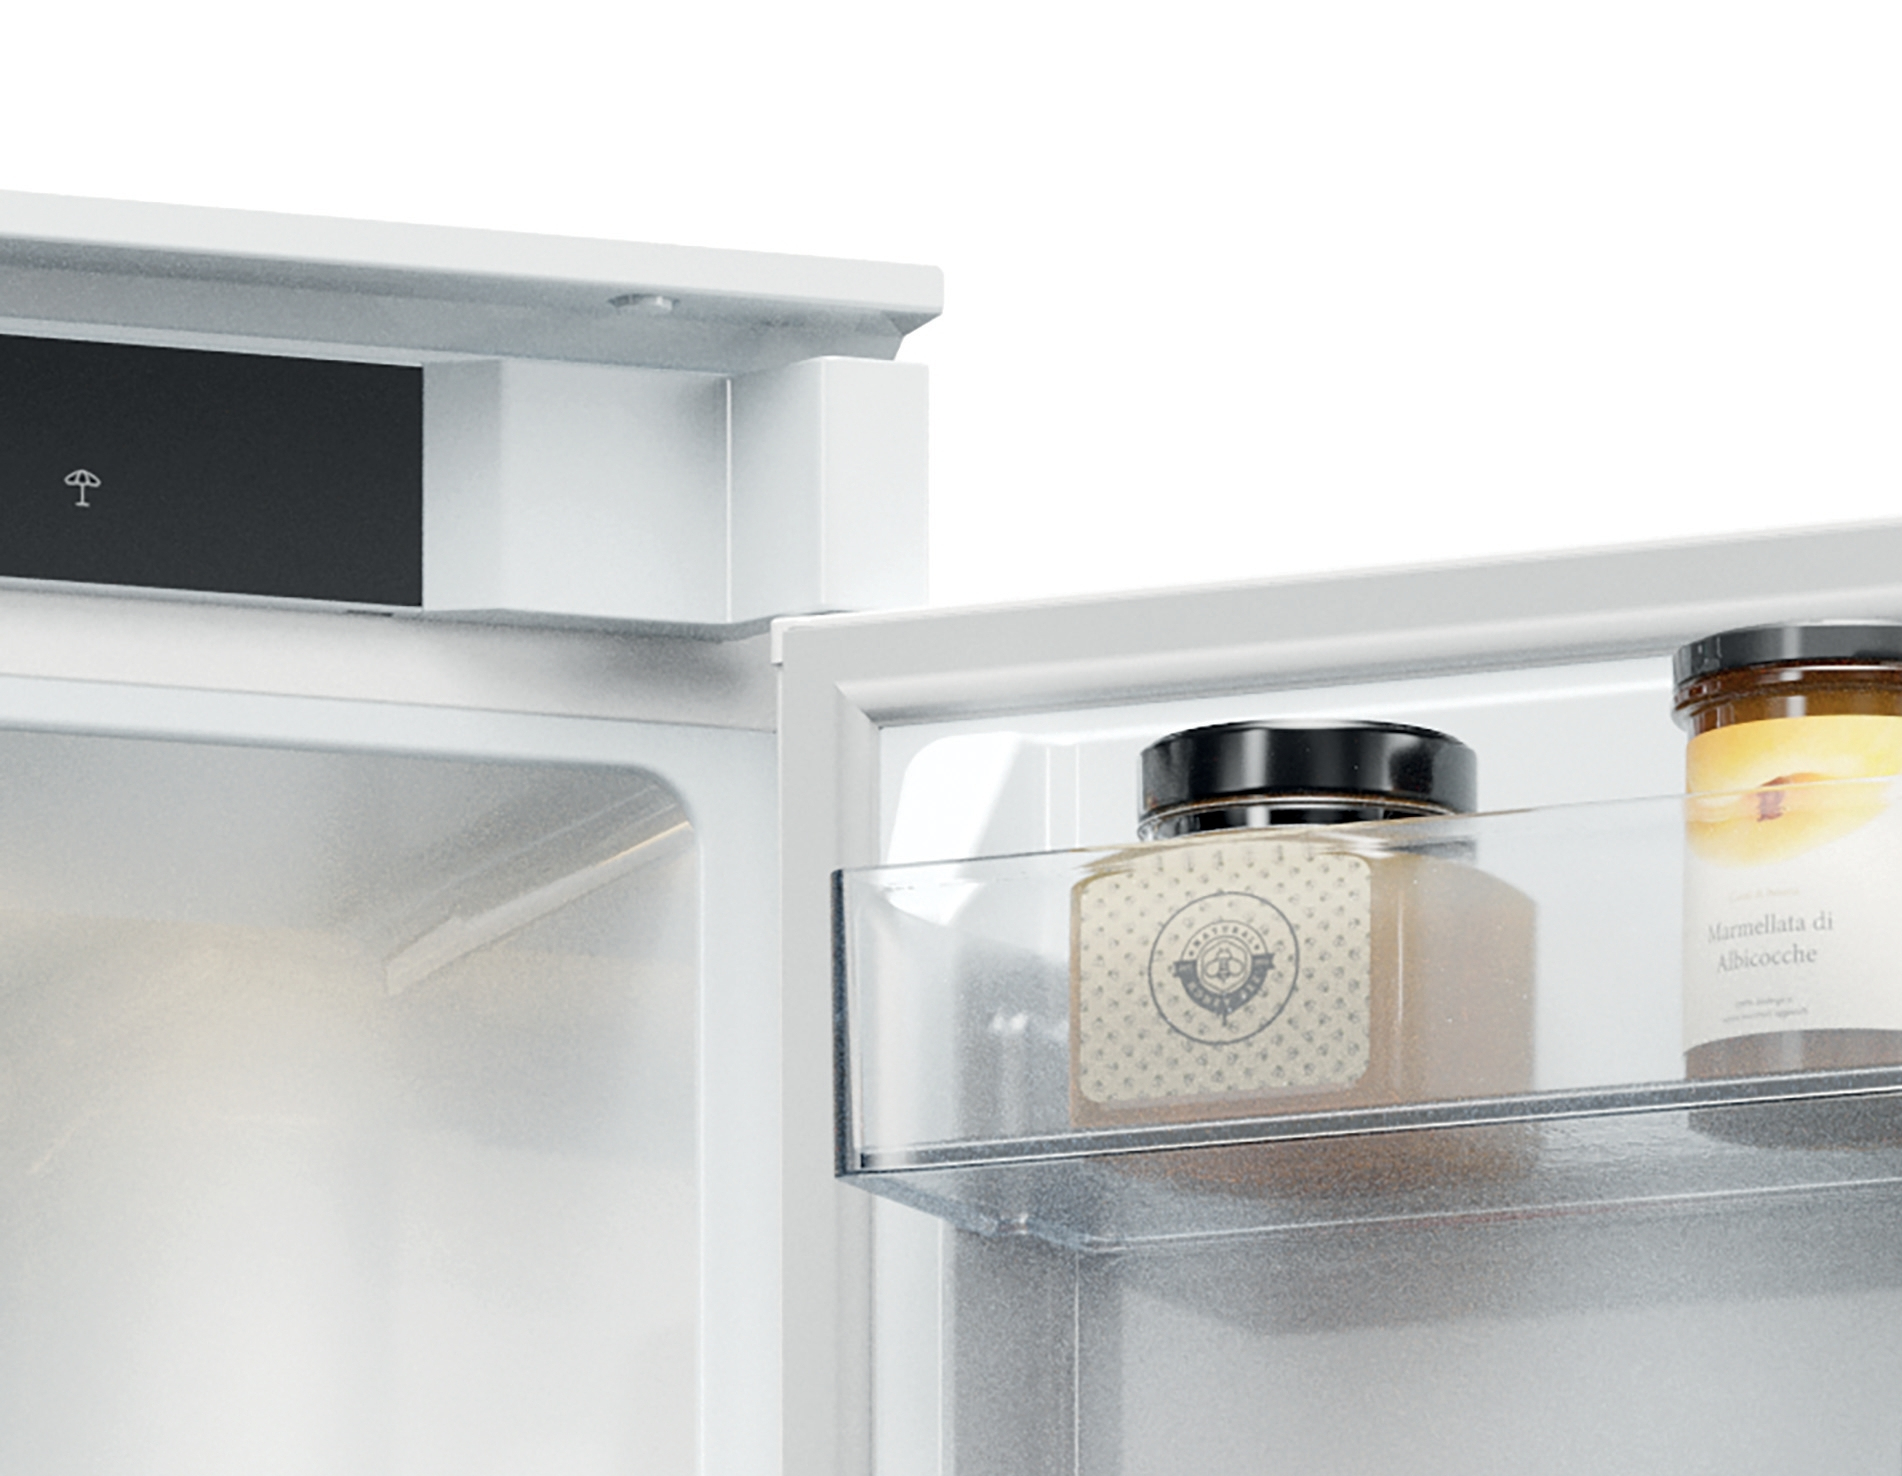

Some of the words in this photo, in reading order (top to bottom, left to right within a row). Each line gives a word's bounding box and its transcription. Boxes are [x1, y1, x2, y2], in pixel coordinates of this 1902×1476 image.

[1708, 913, 1806, 943] Marmellata
[1812, 910, 1833, 931] di
[1717, 943, 1818, 973] Albicocche
